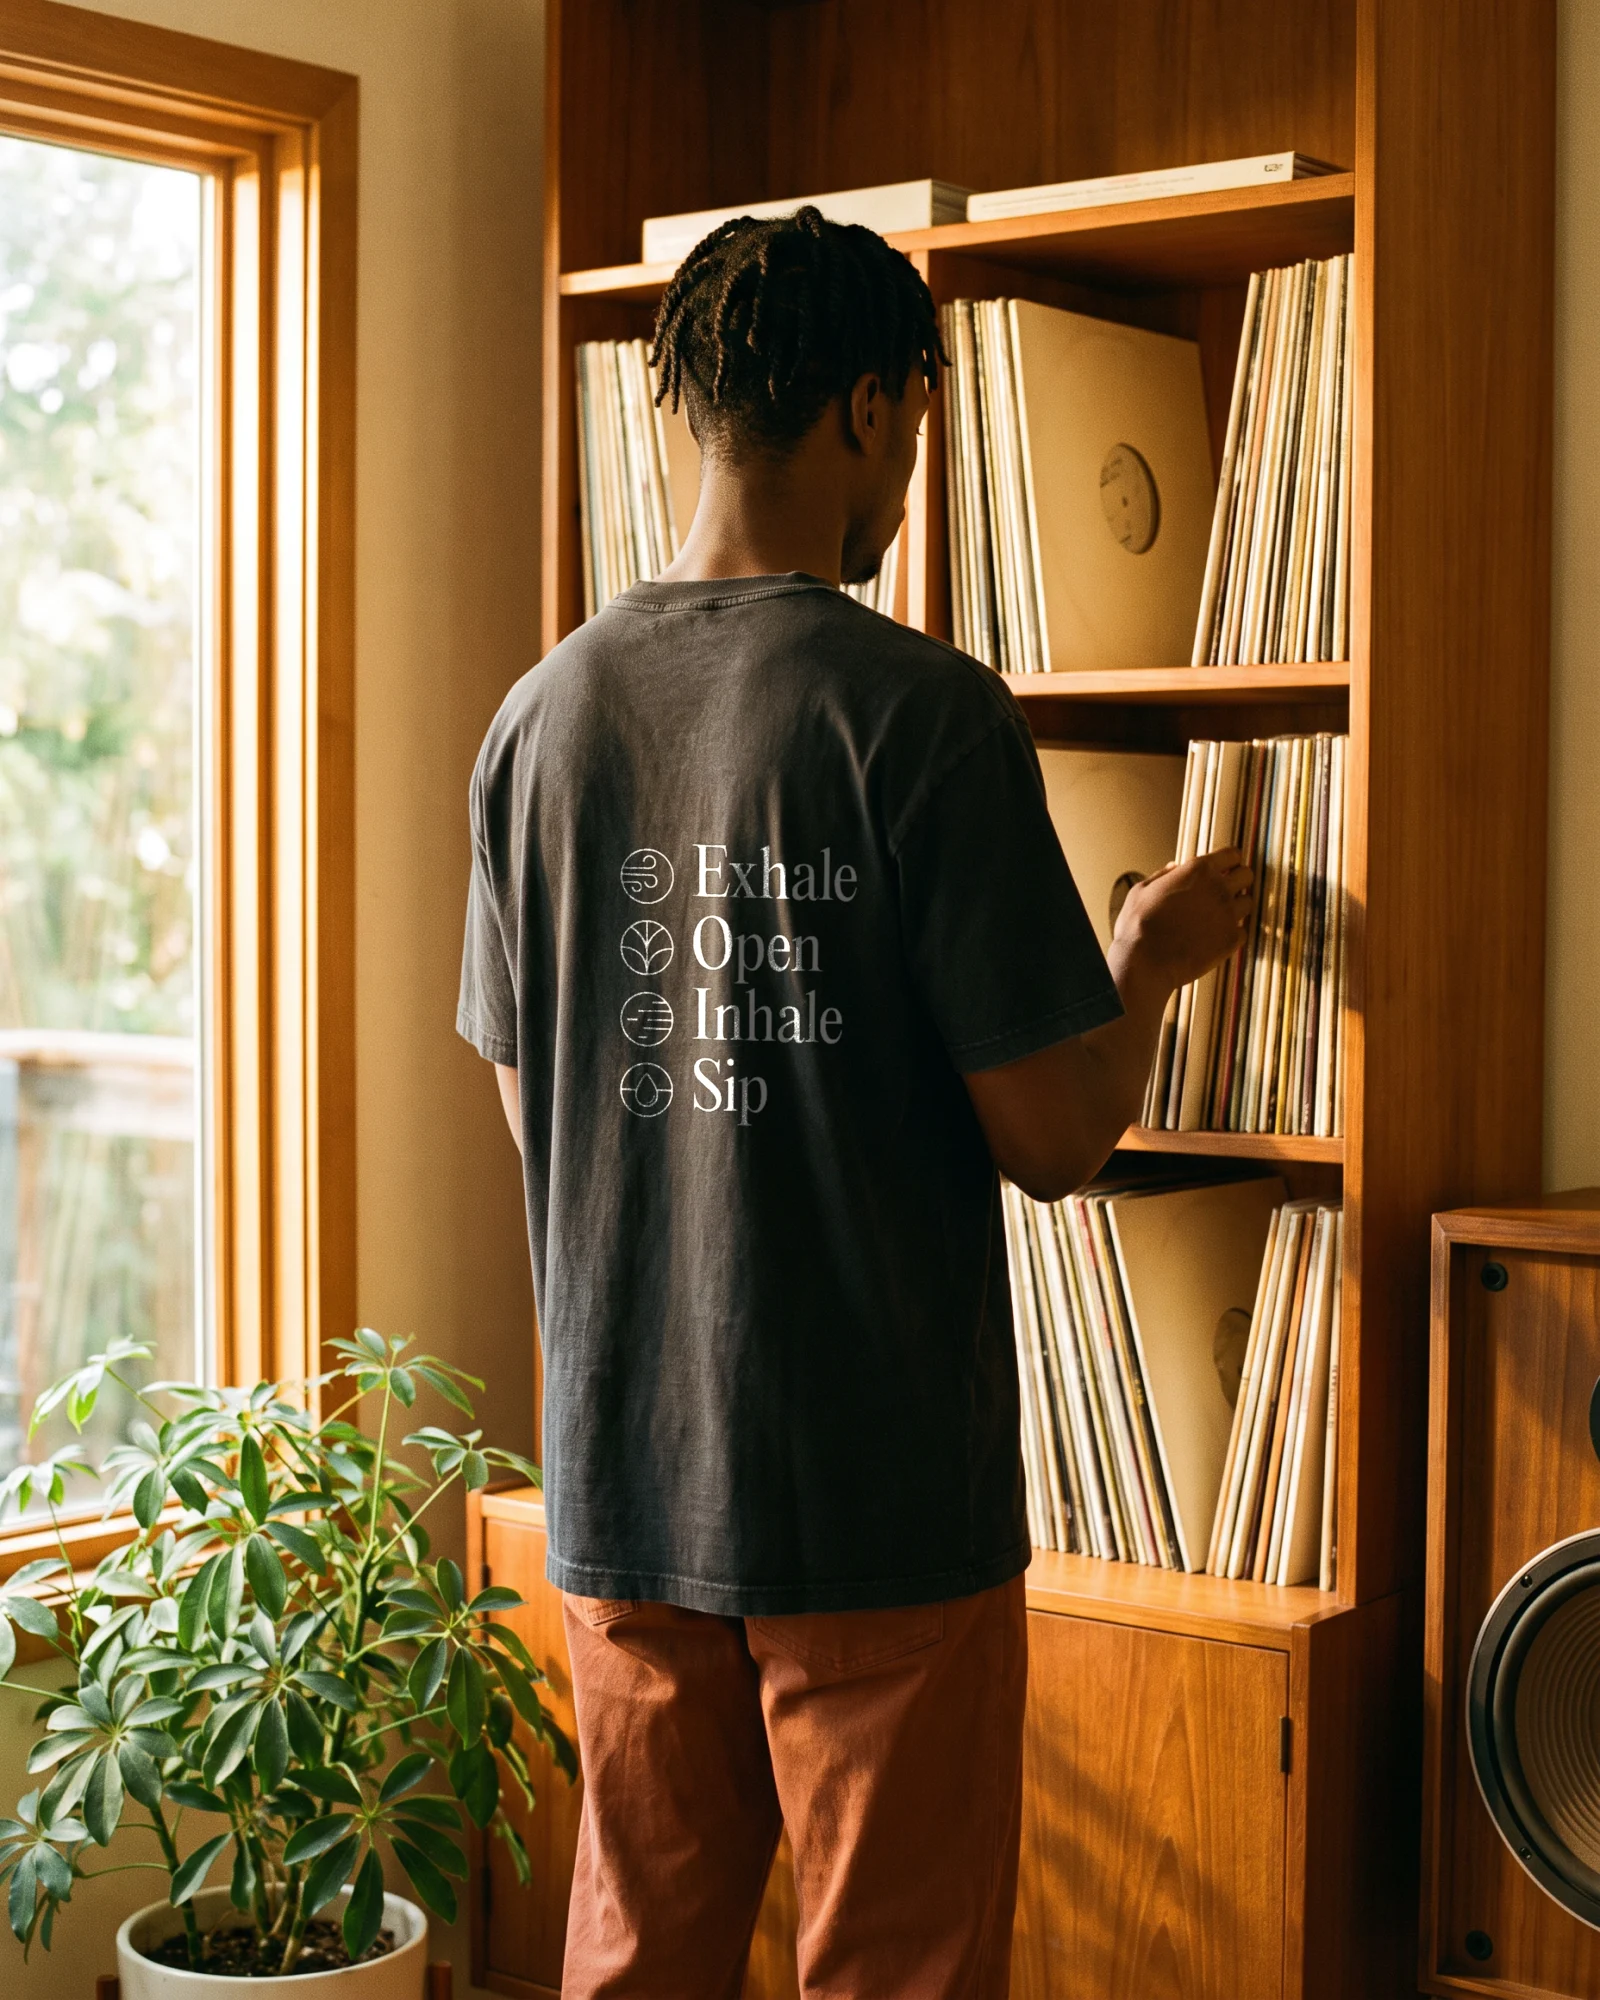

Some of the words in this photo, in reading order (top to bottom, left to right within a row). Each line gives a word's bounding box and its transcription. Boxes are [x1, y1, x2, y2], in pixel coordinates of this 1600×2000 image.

[692, 843, 858, 902] Exhale
[692, 915, 823, 984] Open
[692, 987, 843, 1044] Inhale
[692, 1057, 768, 1126] Sip
